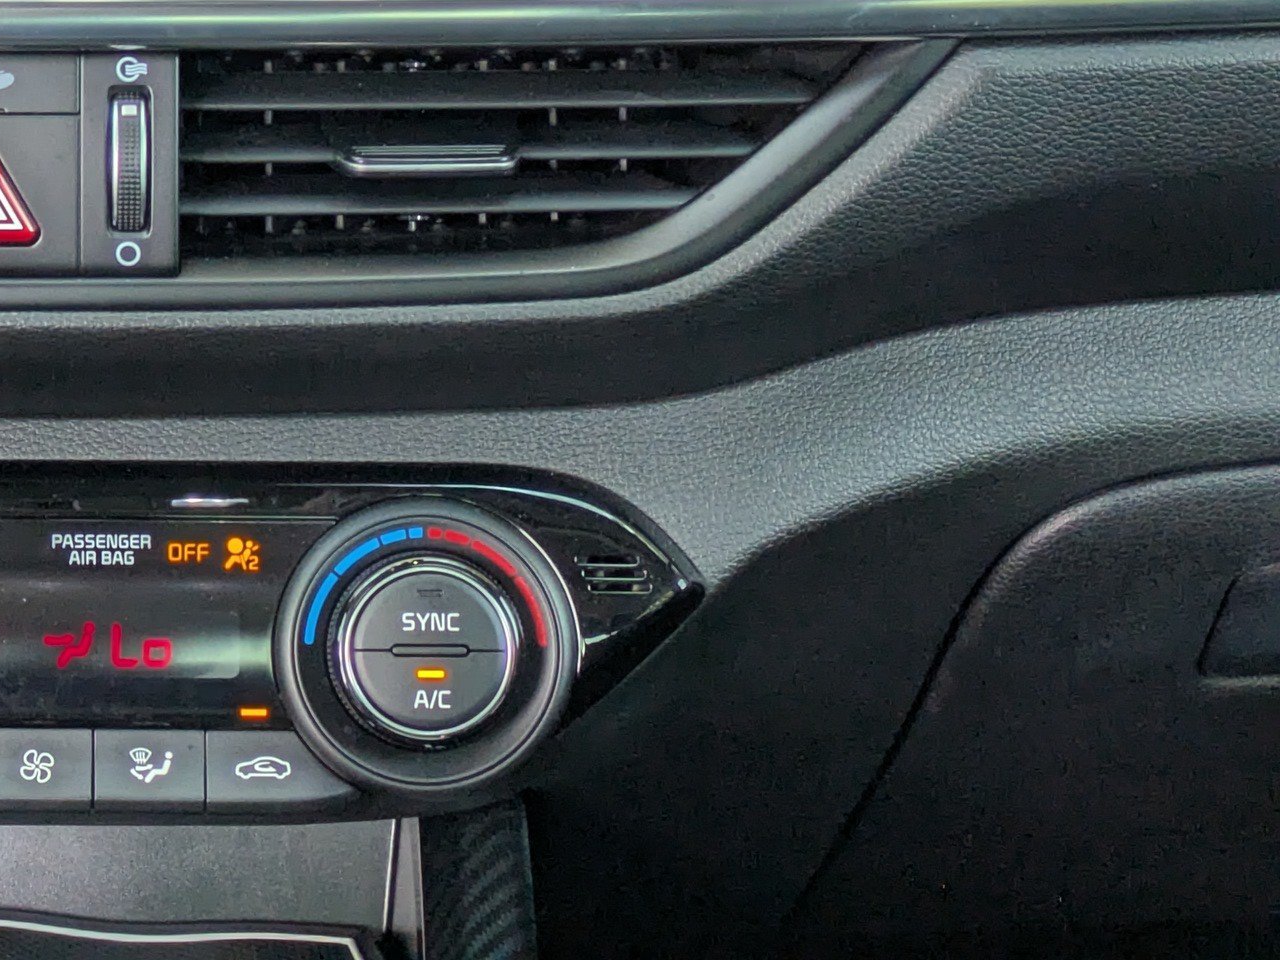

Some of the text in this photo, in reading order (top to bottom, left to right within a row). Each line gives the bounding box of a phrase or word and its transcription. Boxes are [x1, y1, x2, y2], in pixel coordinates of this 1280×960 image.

[51, 534, 151, 550] PASSENGER
[68, 550, 135, 566] AIR BAG
[167, 543, 210, 563] OFF
[402, 613, 460, 632] SYNC
[110, 623, 172, 668] Lo
[414, 689, 452, 709] A/C
